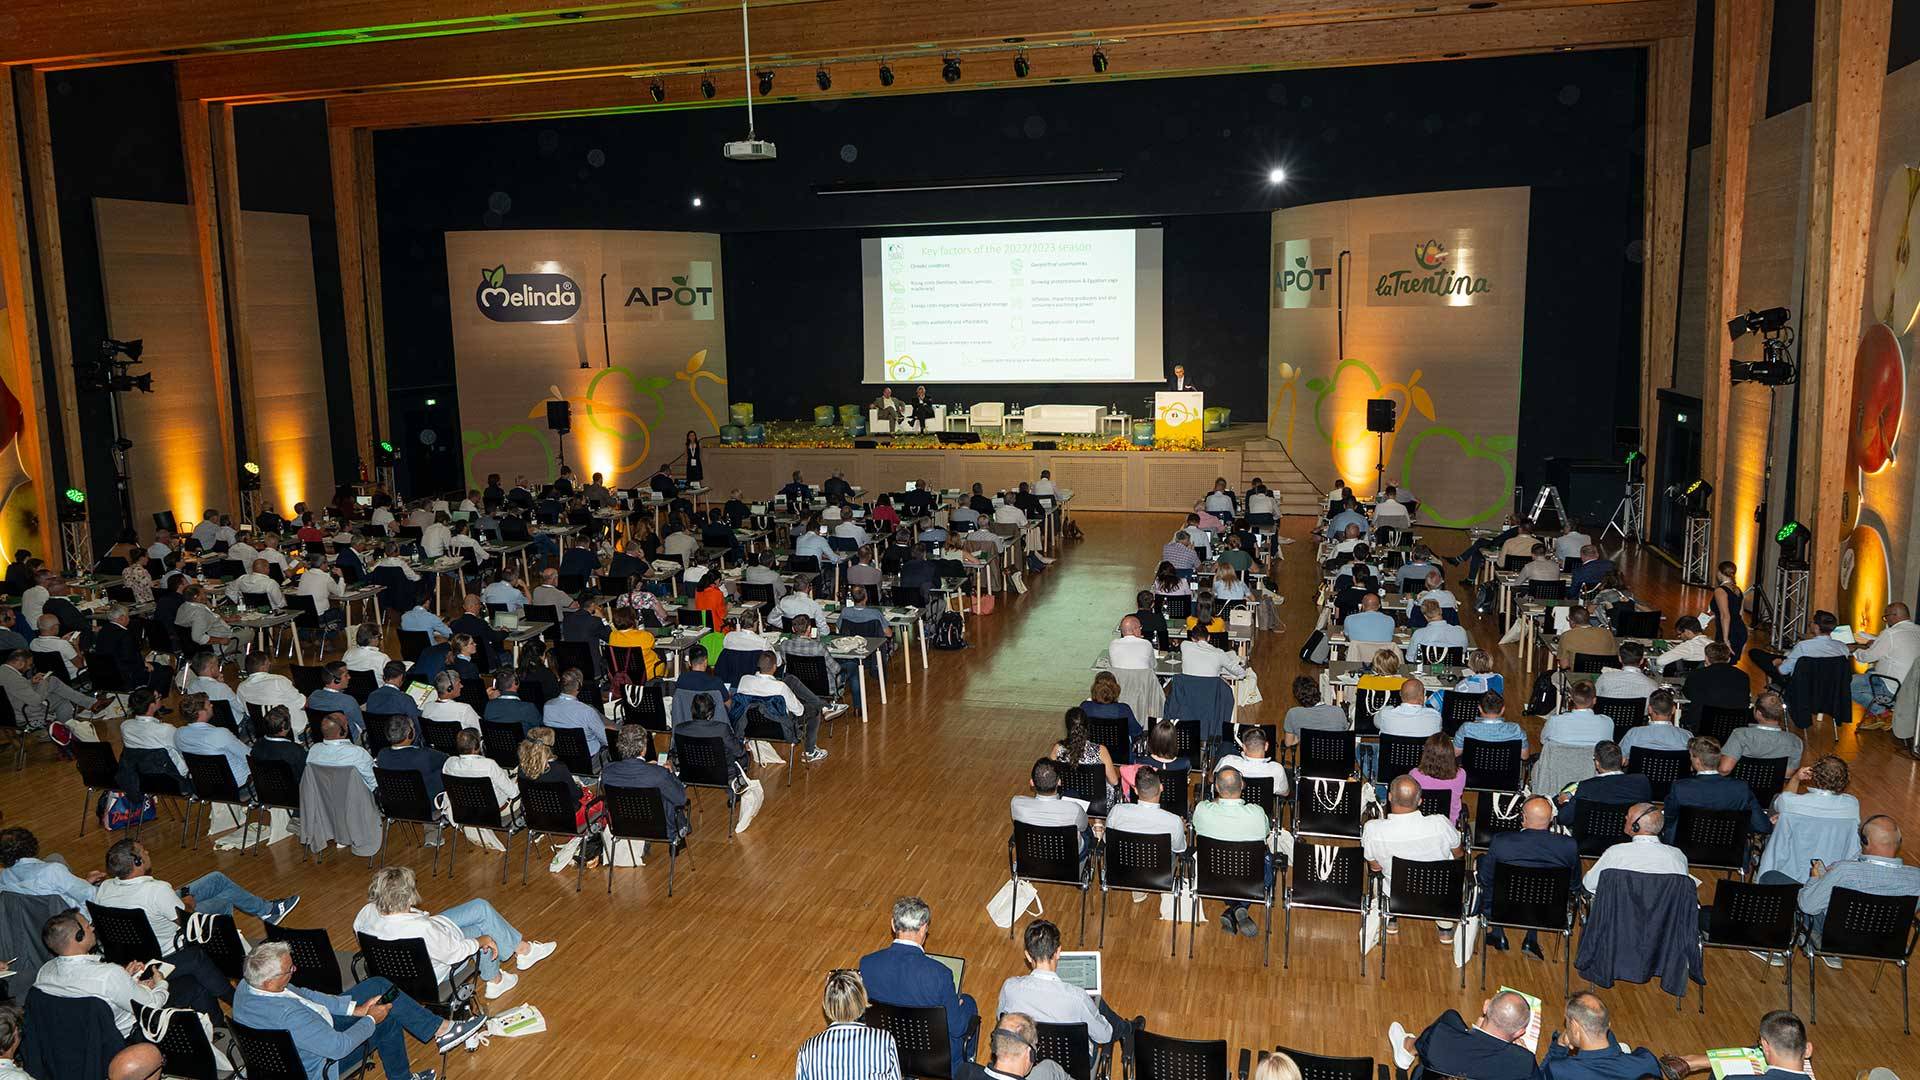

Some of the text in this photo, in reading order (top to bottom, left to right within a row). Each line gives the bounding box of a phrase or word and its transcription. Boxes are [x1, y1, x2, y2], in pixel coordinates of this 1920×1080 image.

[921, 243, 1092, 257] Key factors of the 2022/2023 season
[1275, 268, 1332, 292] APOT
[624, 287, 713, 307] APOT
